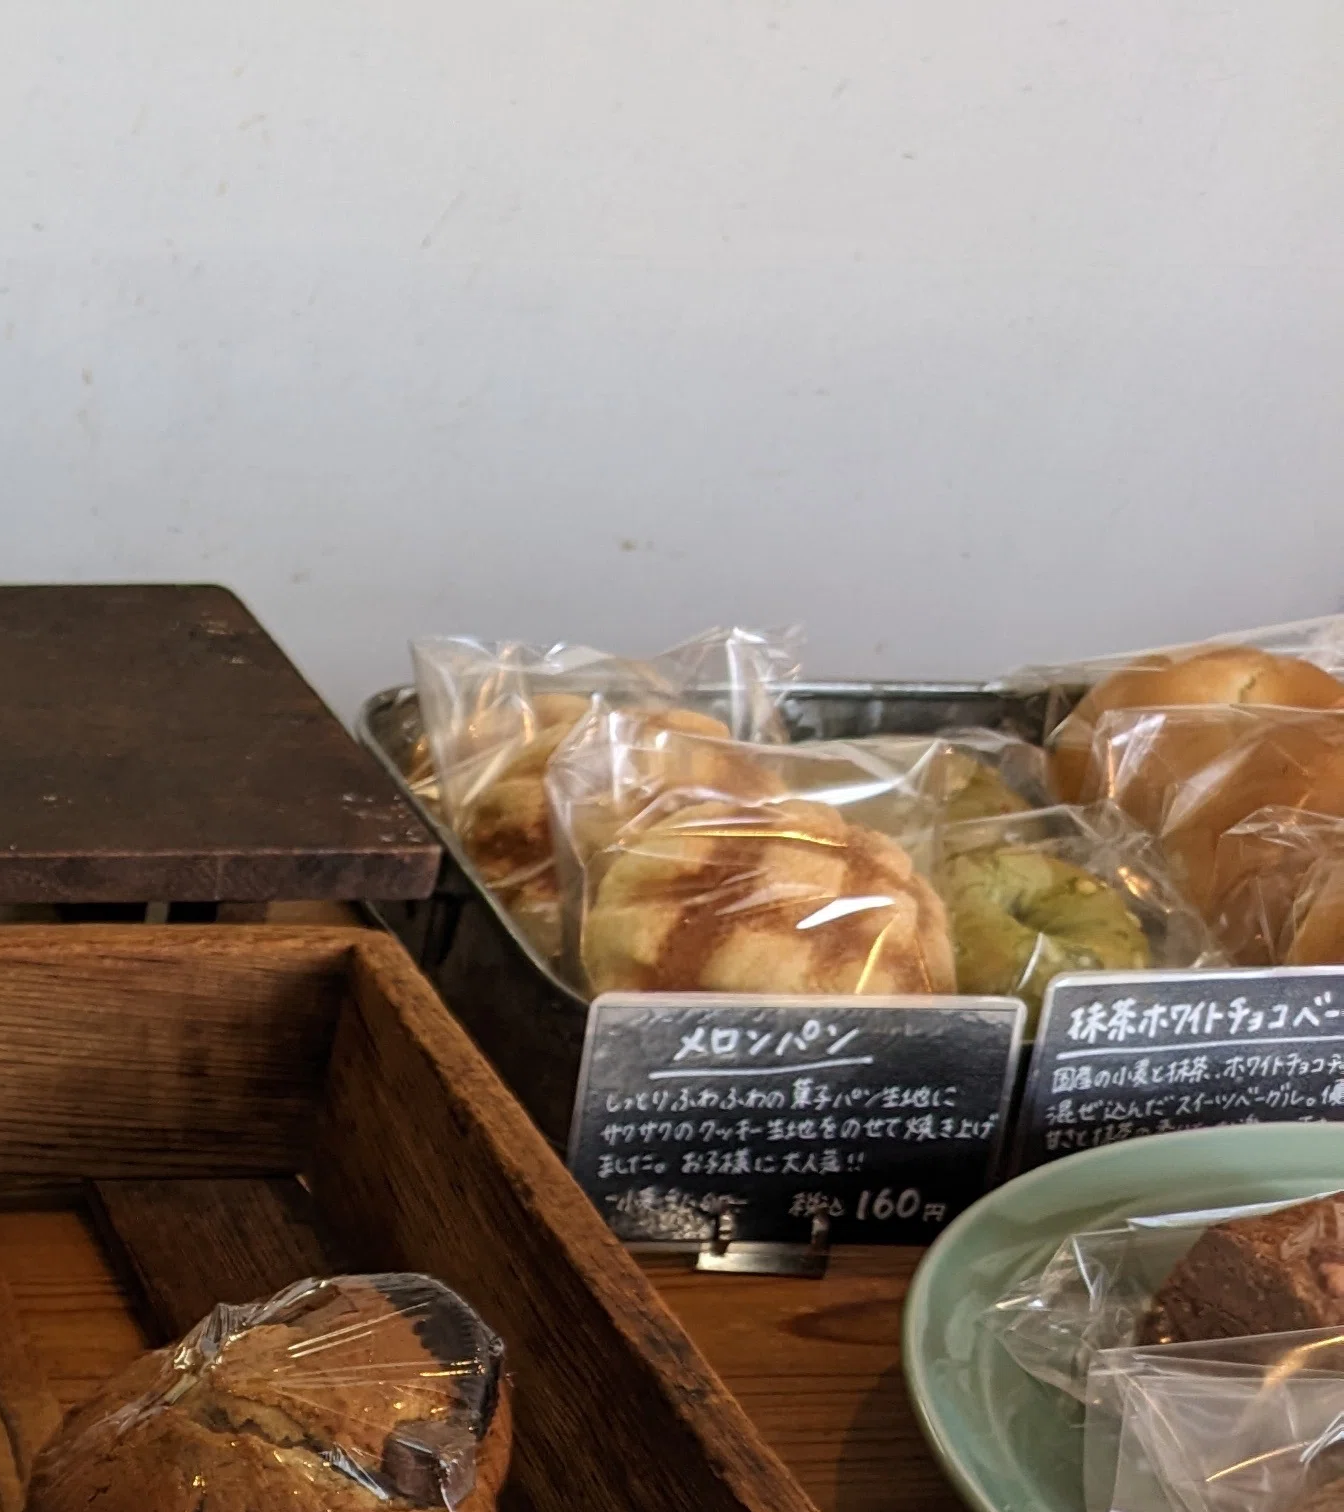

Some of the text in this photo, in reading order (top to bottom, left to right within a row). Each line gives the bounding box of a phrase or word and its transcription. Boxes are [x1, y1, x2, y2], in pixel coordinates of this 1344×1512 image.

[673, 1020, 861, 1061] メロンパン
